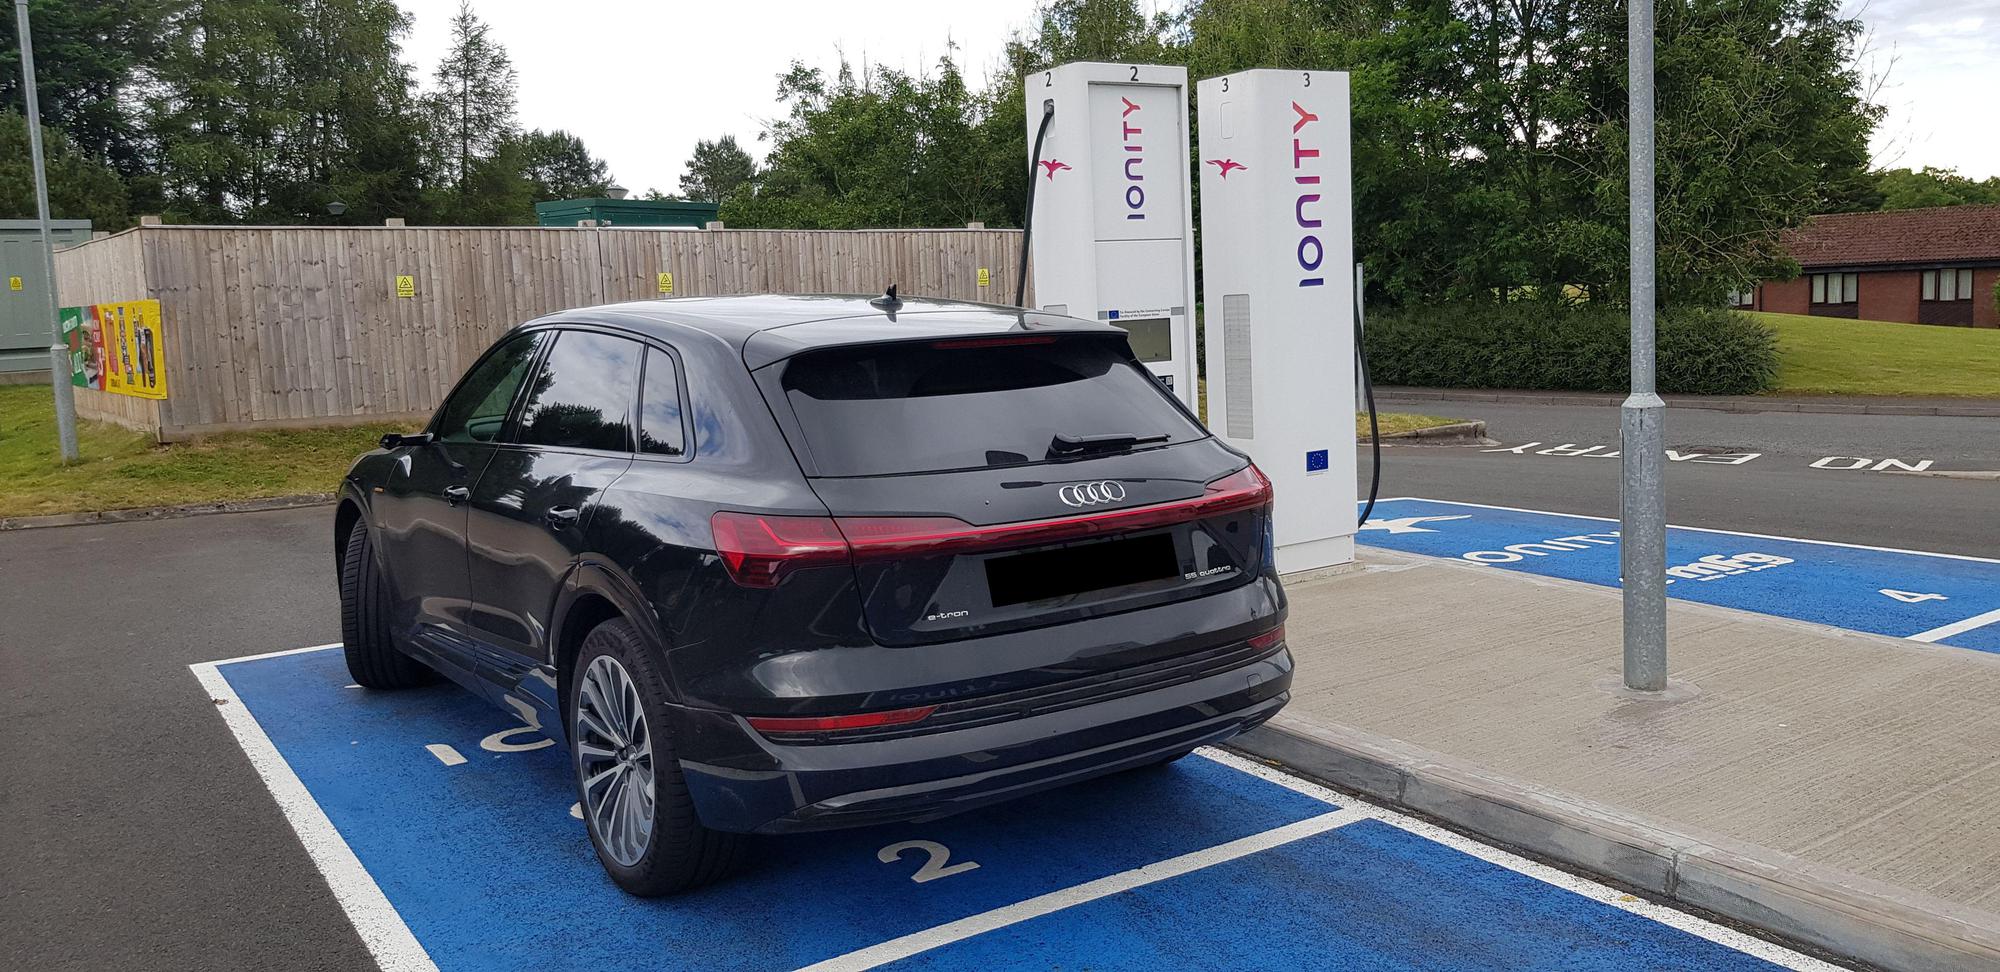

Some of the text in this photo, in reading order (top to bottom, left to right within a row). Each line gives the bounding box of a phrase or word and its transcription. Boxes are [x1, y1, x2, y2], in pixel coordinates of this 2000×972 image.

[1045, 71, 1053, 88] 2
[1130, 66, 1139, 82] 2
[1303, 72, 1311, 87] 3
[1221, 77, 1229, 93] 3
[1121, 96, 1146, 220] IONITY
[1292, 100, 1325, 288] IONITY
[1808, 456, 1935, 473] NO
[1184, 564, 1232, 580] 55 quattro
[1879, 587, 1950, 604] 4
[927, 609, 969, 622] e-tron
[877, 839, 981, 884] 2
